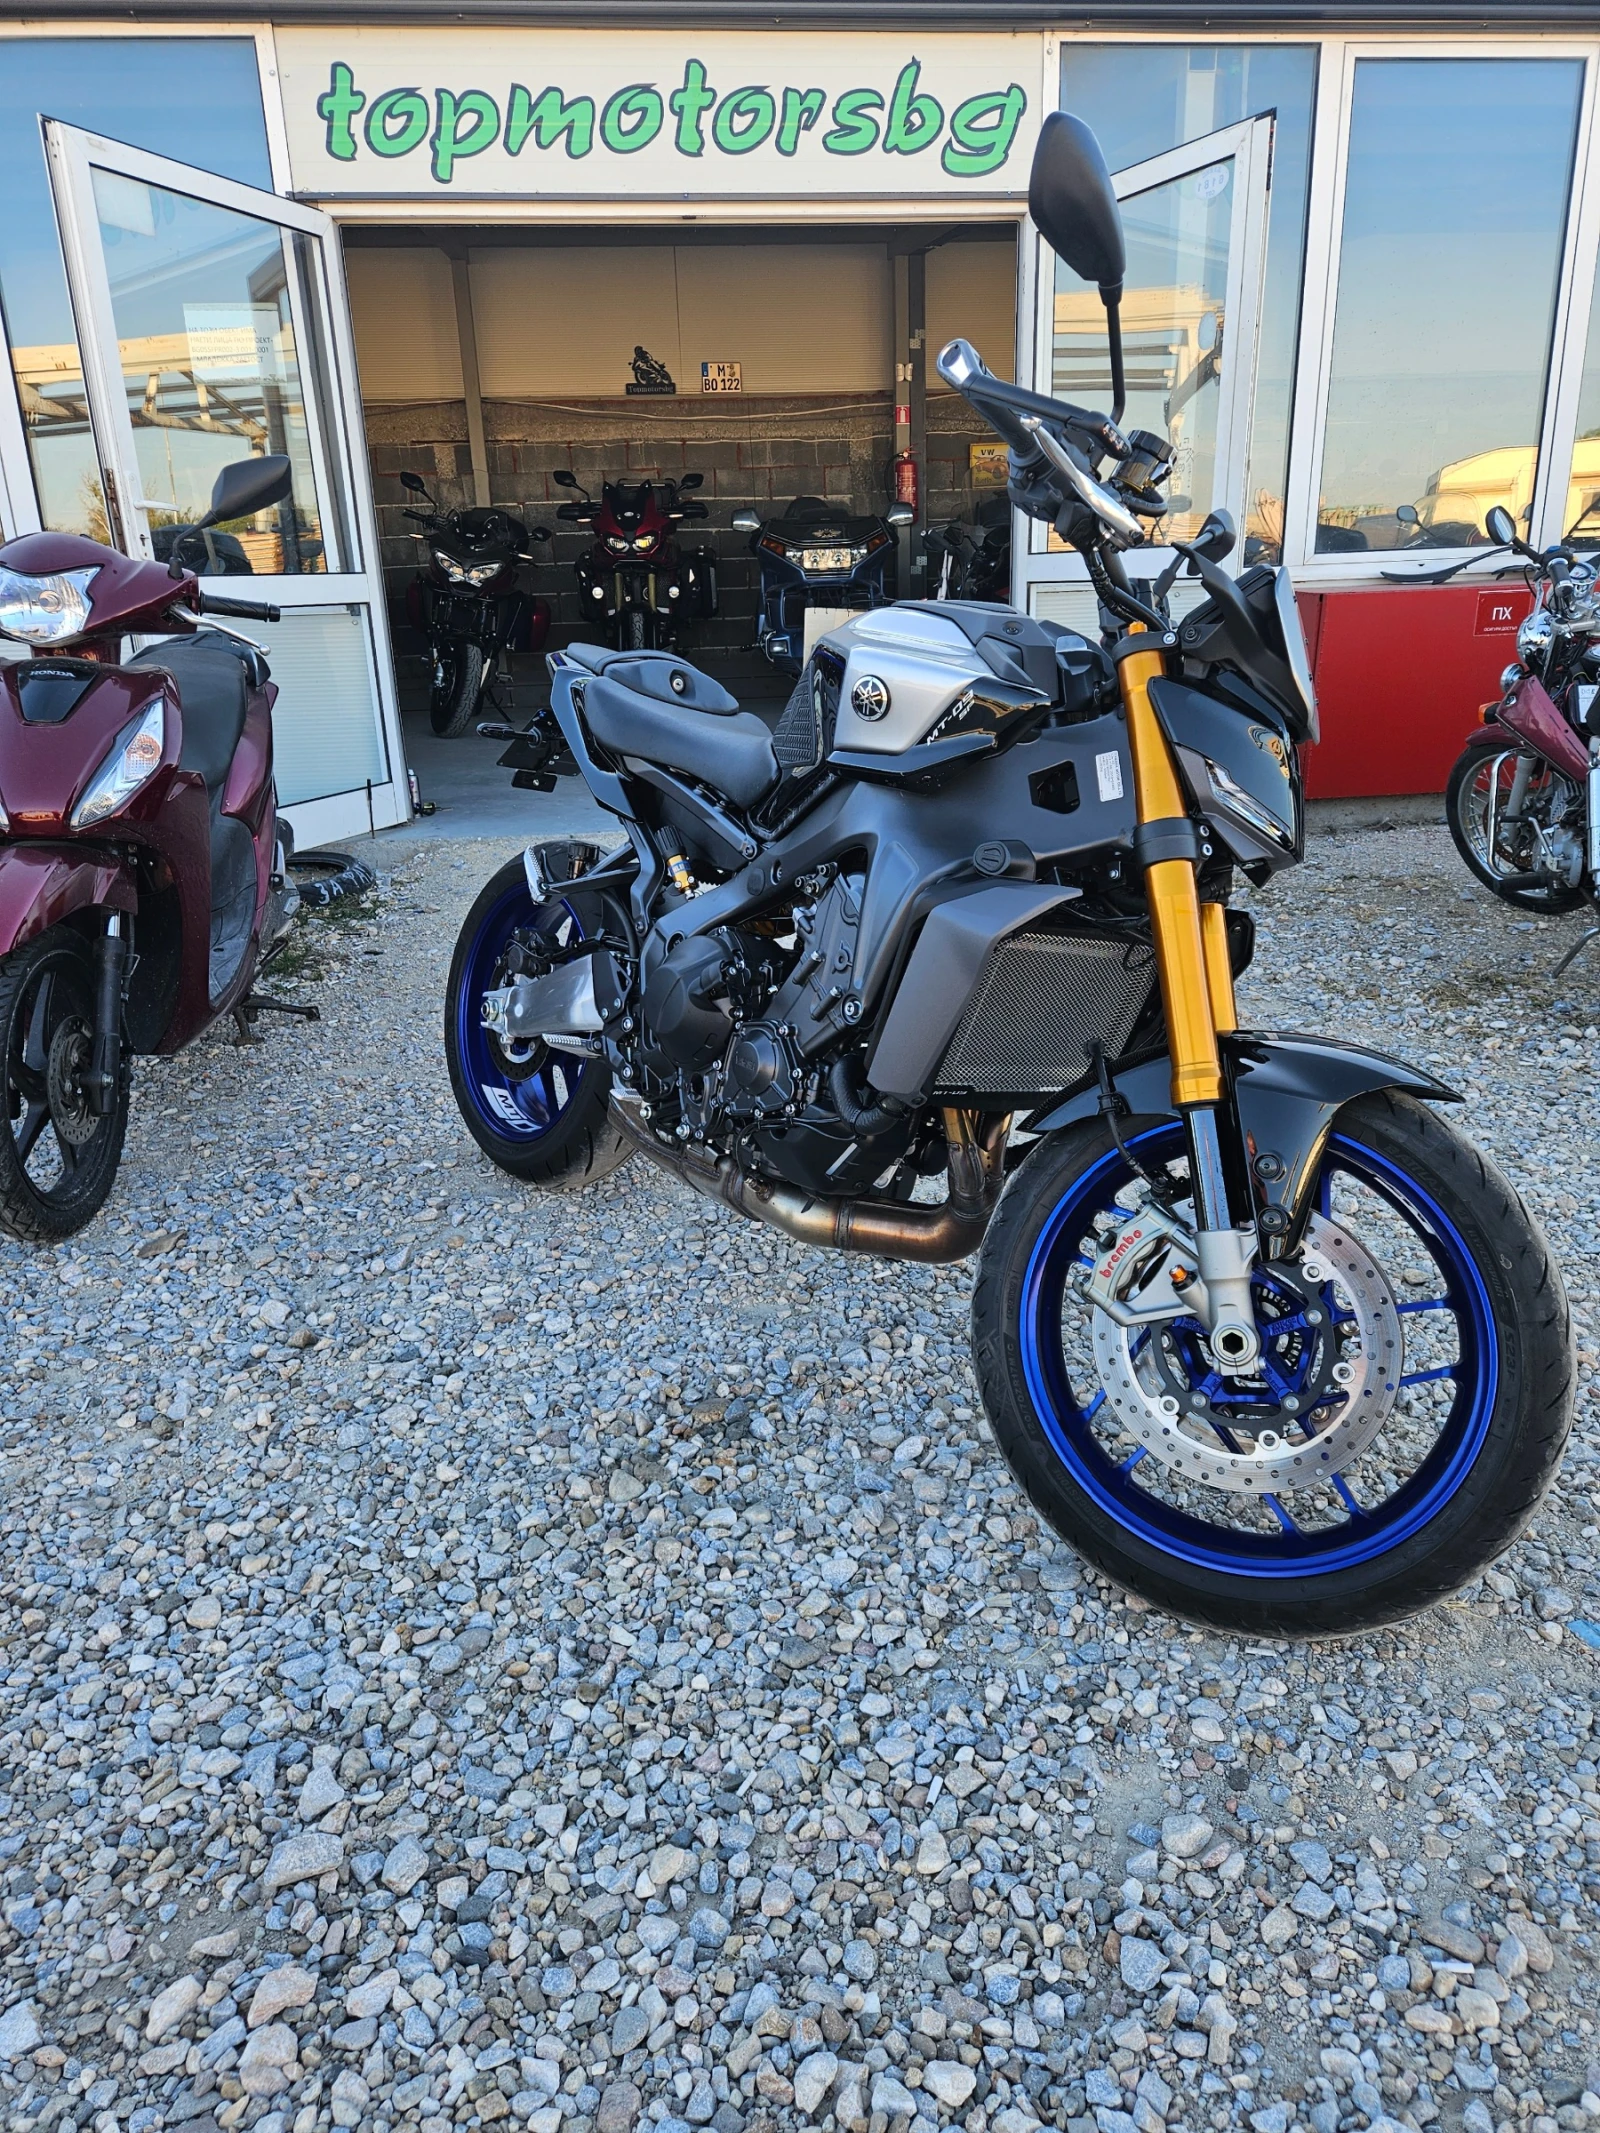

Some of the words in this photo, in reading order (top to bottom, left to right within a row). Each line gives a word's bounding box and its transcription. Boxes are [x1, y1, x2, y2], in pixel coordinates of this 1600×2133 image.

[317, 56, 1026, 184] topmotorsbg
[717, 364, 726, 377] M
[720, 378, 740, 391] 122
[1492, 606, 1513, 620] ПХ
[29, 670, 76, 678] HONDA
[926, 689, 974, 746] MT-09
[958, 699, 975, 721] SP
[1098, 1229, 1143, 1279] brembo
